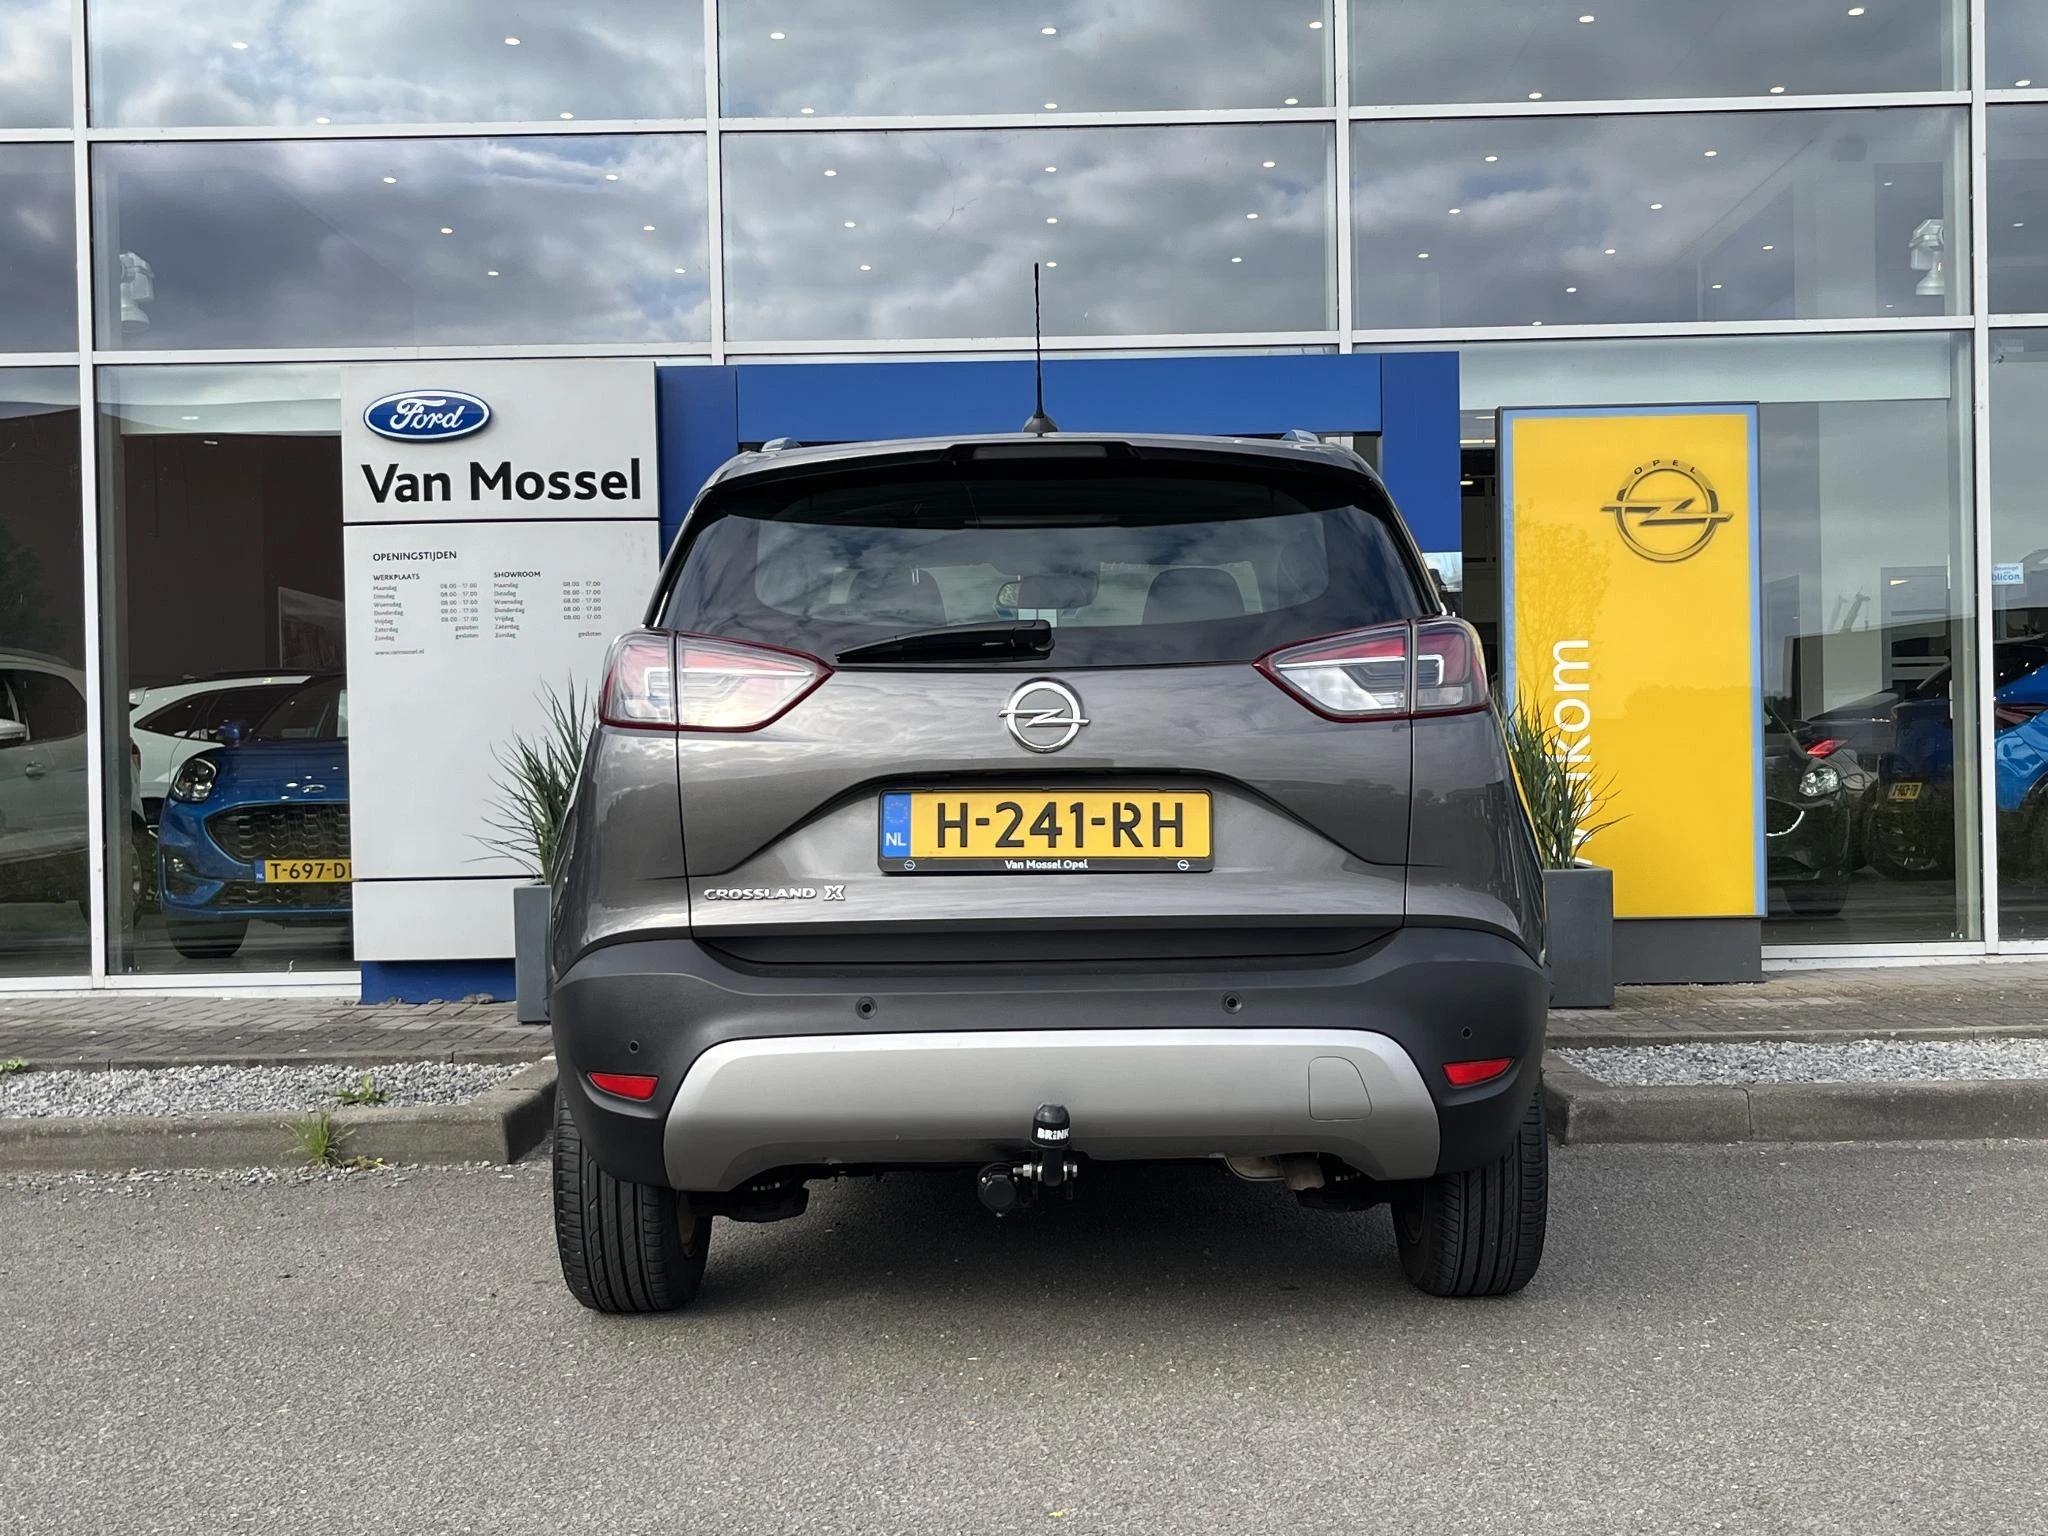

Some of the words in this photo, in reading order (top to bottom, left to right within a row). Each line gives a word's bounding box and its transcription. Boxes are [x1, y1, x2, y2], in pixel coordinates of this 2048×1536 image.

[389, 398, 465, 430] Ford
[1633, 459, 1697, 475] OPEL
[361, 463, 451, 503] Van
[469, 458, 641, 501] Mossel
[372, 551, 457, 561] OPENINGSTIJDEN
[373, 573, 420, 581] WERKPLAATS
[937, 801, 1183, 848] H-241-RH
[885, 832, 907, 847] NL
[1004, 860, 1024, 869] Van
[1026, 859, 1061, 869] Mossel
[1063, 859, 1088, 870] Opel
[703, 887, 817, 901] CROSSLAND
[823, 884, 846, 901] X
